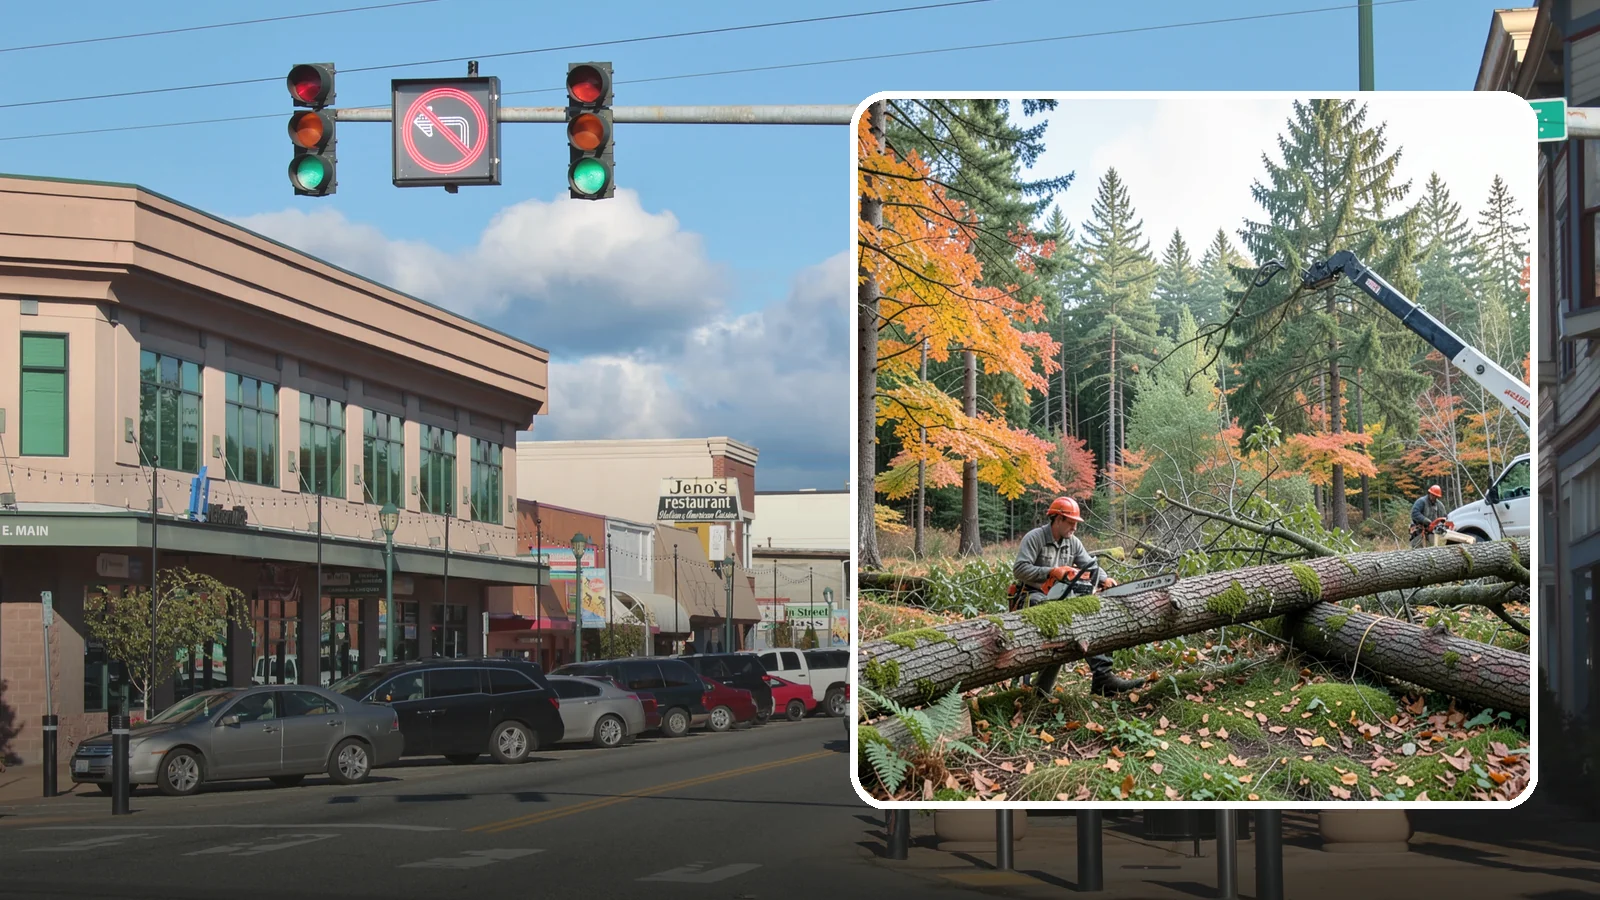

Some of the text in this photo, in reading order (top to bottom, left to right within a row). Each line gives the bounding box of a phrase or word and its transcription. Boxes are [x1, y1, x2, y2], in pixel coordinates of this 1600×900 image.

[669, 480, 727, 495] Jeno's
[665, 496, 731, 509] restaurant
[658, 509, 681, 519] Italian
[686, 509, 715, 519] American
[715, 509, 738, 519] Cuisine
[2, 525, 49, 536] E. MAIN
[797, 607, 828, 617] Street
[791, 619, 824, 627] lass
